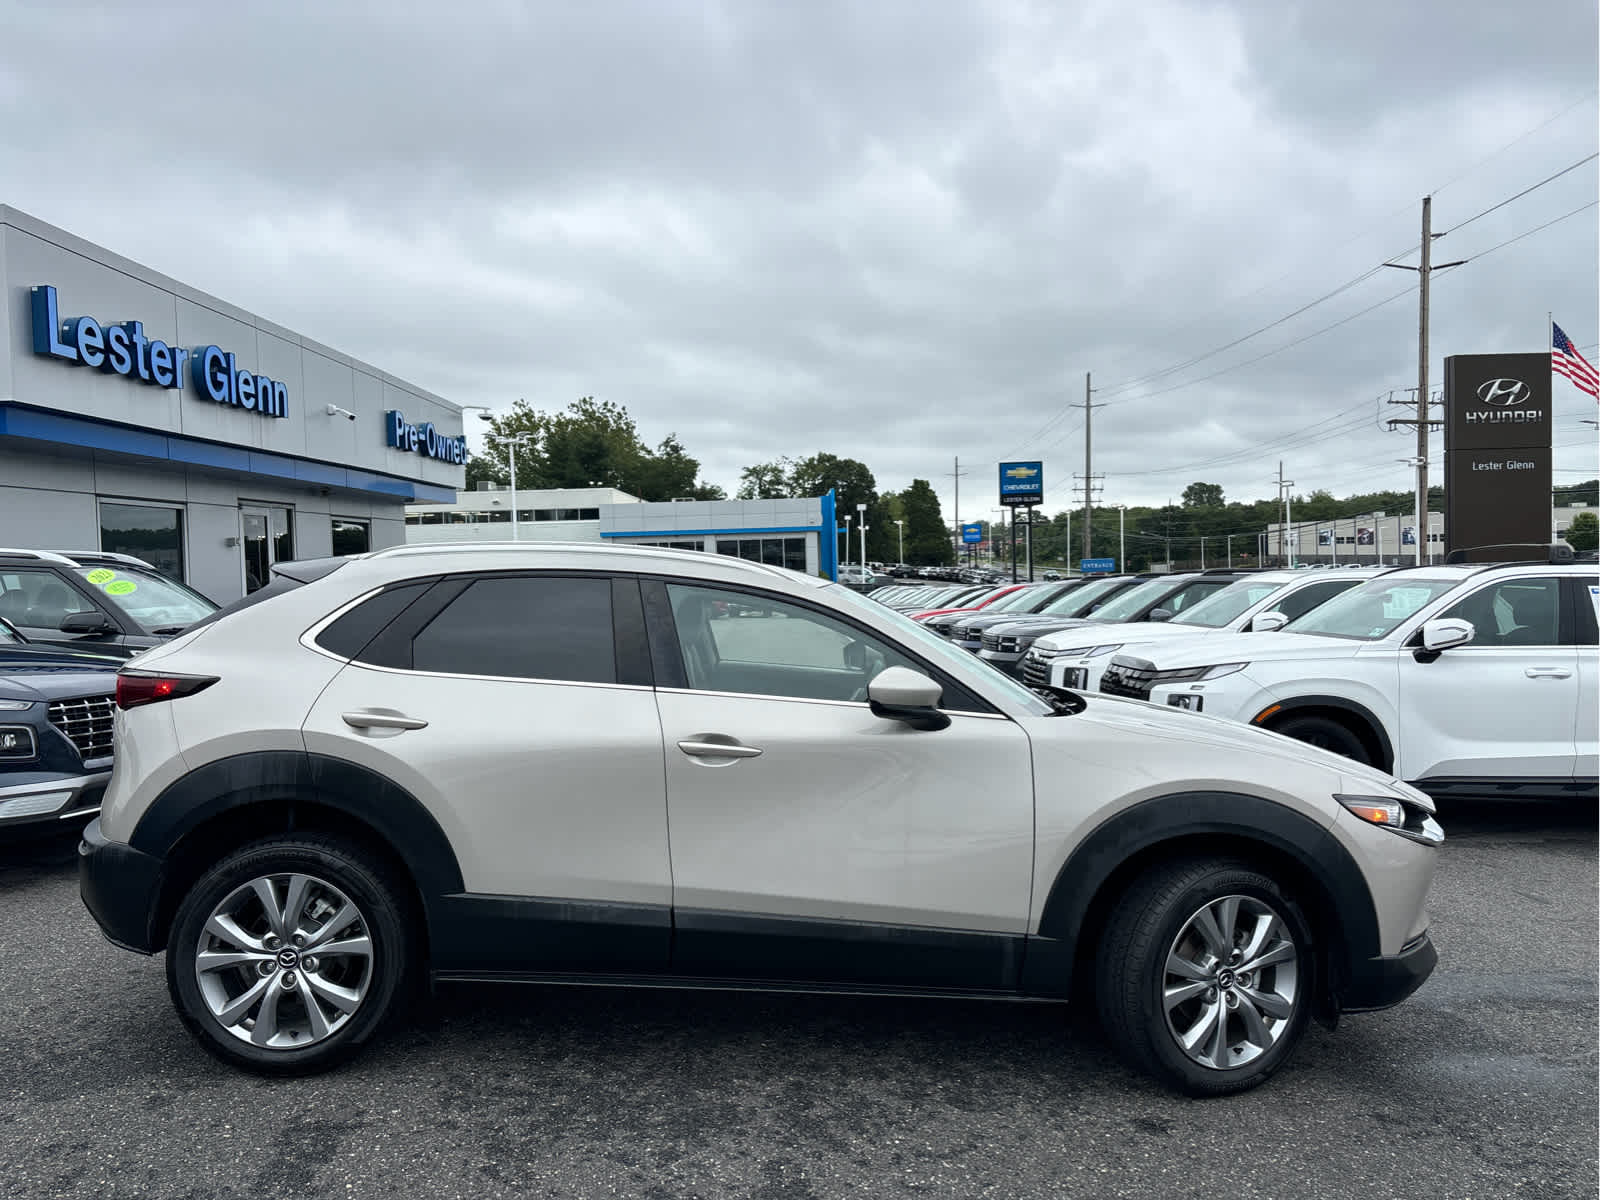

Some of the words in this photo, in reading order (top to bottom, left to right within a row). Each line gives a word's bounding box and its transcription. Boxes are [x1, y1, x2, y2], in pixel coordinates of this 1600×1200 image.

[31, 285, 189, 389] Lester
[191, 345, 289, 419] Glenn
[1465, 410, 1542, 423] HYUNDAI
[386, 409, 467, 466] Pre-Owned
[1472, 461, 1503, 471] Lester
[1506, 460, 1536, 470] Glenn
